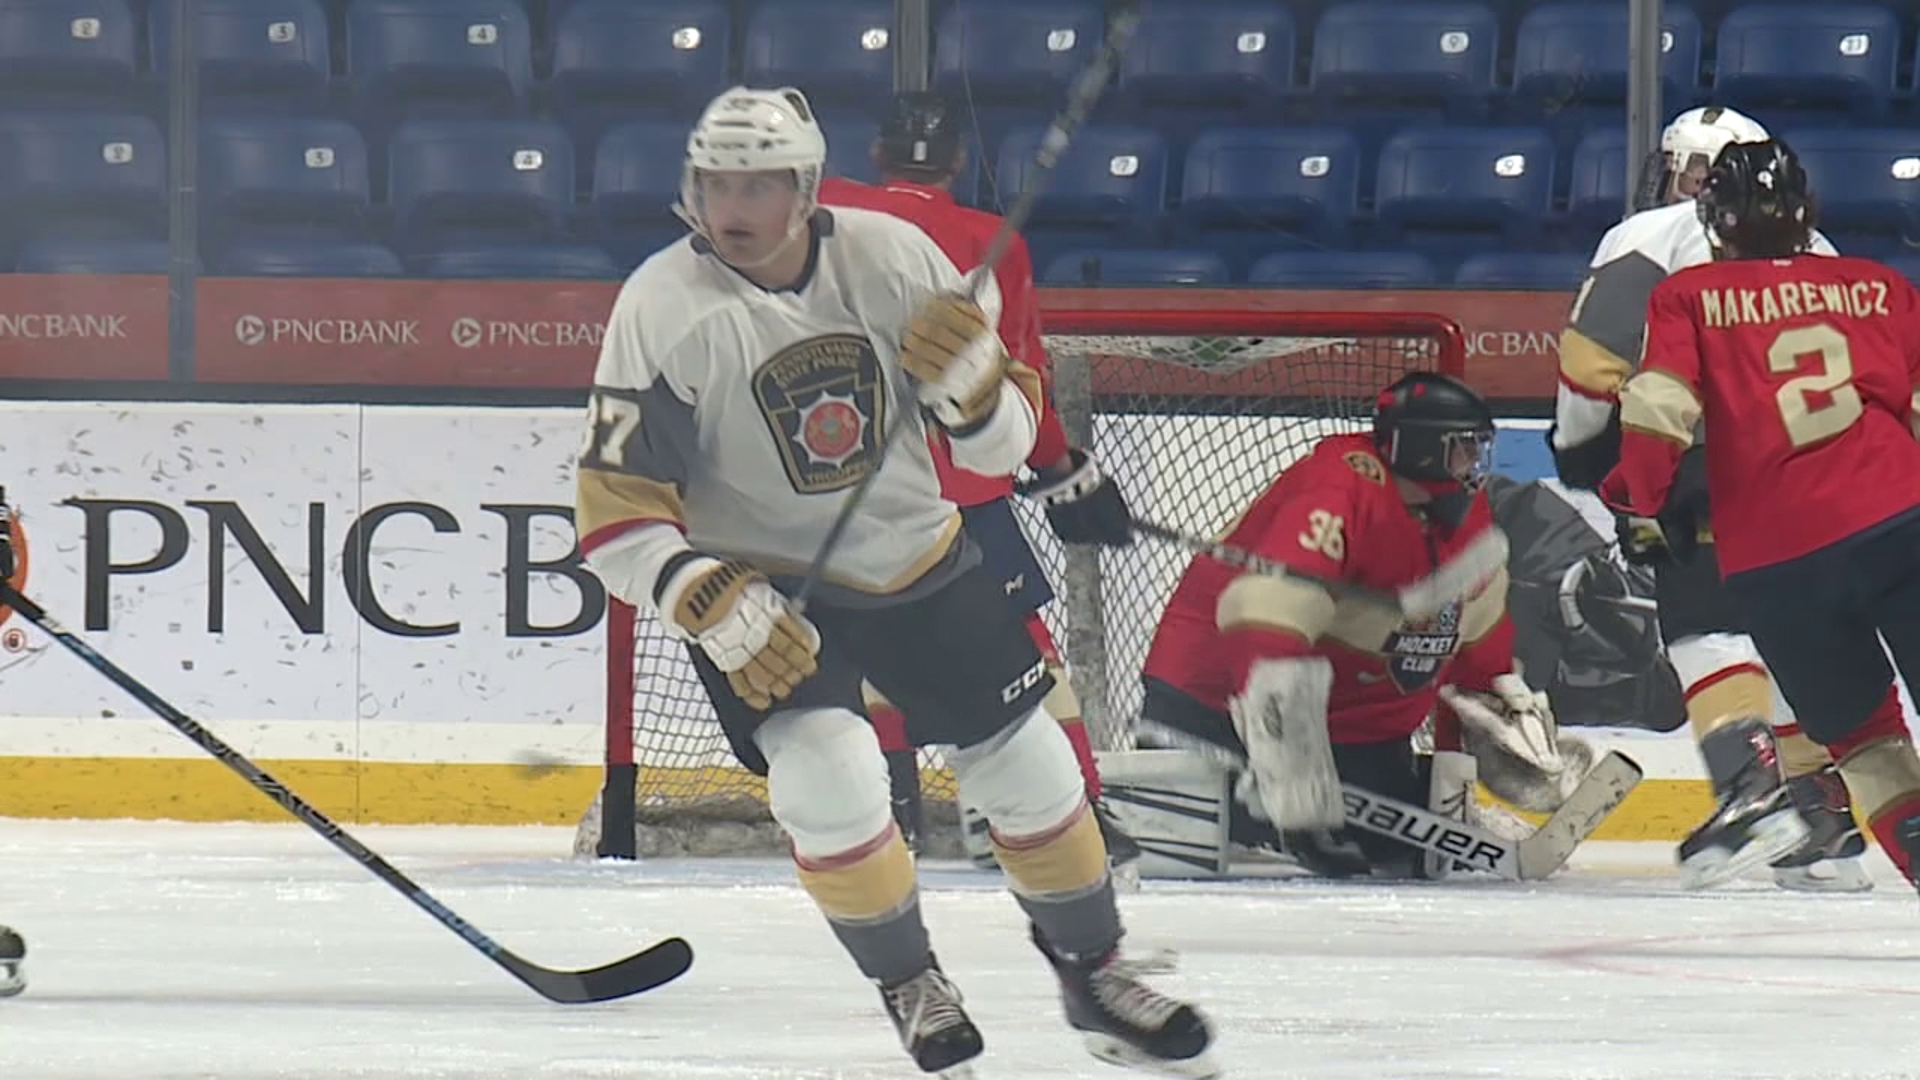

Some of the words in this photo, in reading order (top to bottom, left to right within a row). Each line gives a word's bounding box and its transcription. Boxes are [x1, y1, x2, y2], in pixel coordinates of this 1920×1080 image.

[1701, 280, 1889, 328] MAKAREWICZ
[1766, 322, 1865, 448] 2
[1297, 508, 1346, 563] 36
[1394, 634, 1456, 655] HOCKEY
[1400, 656, 1437, 673] CLUB
